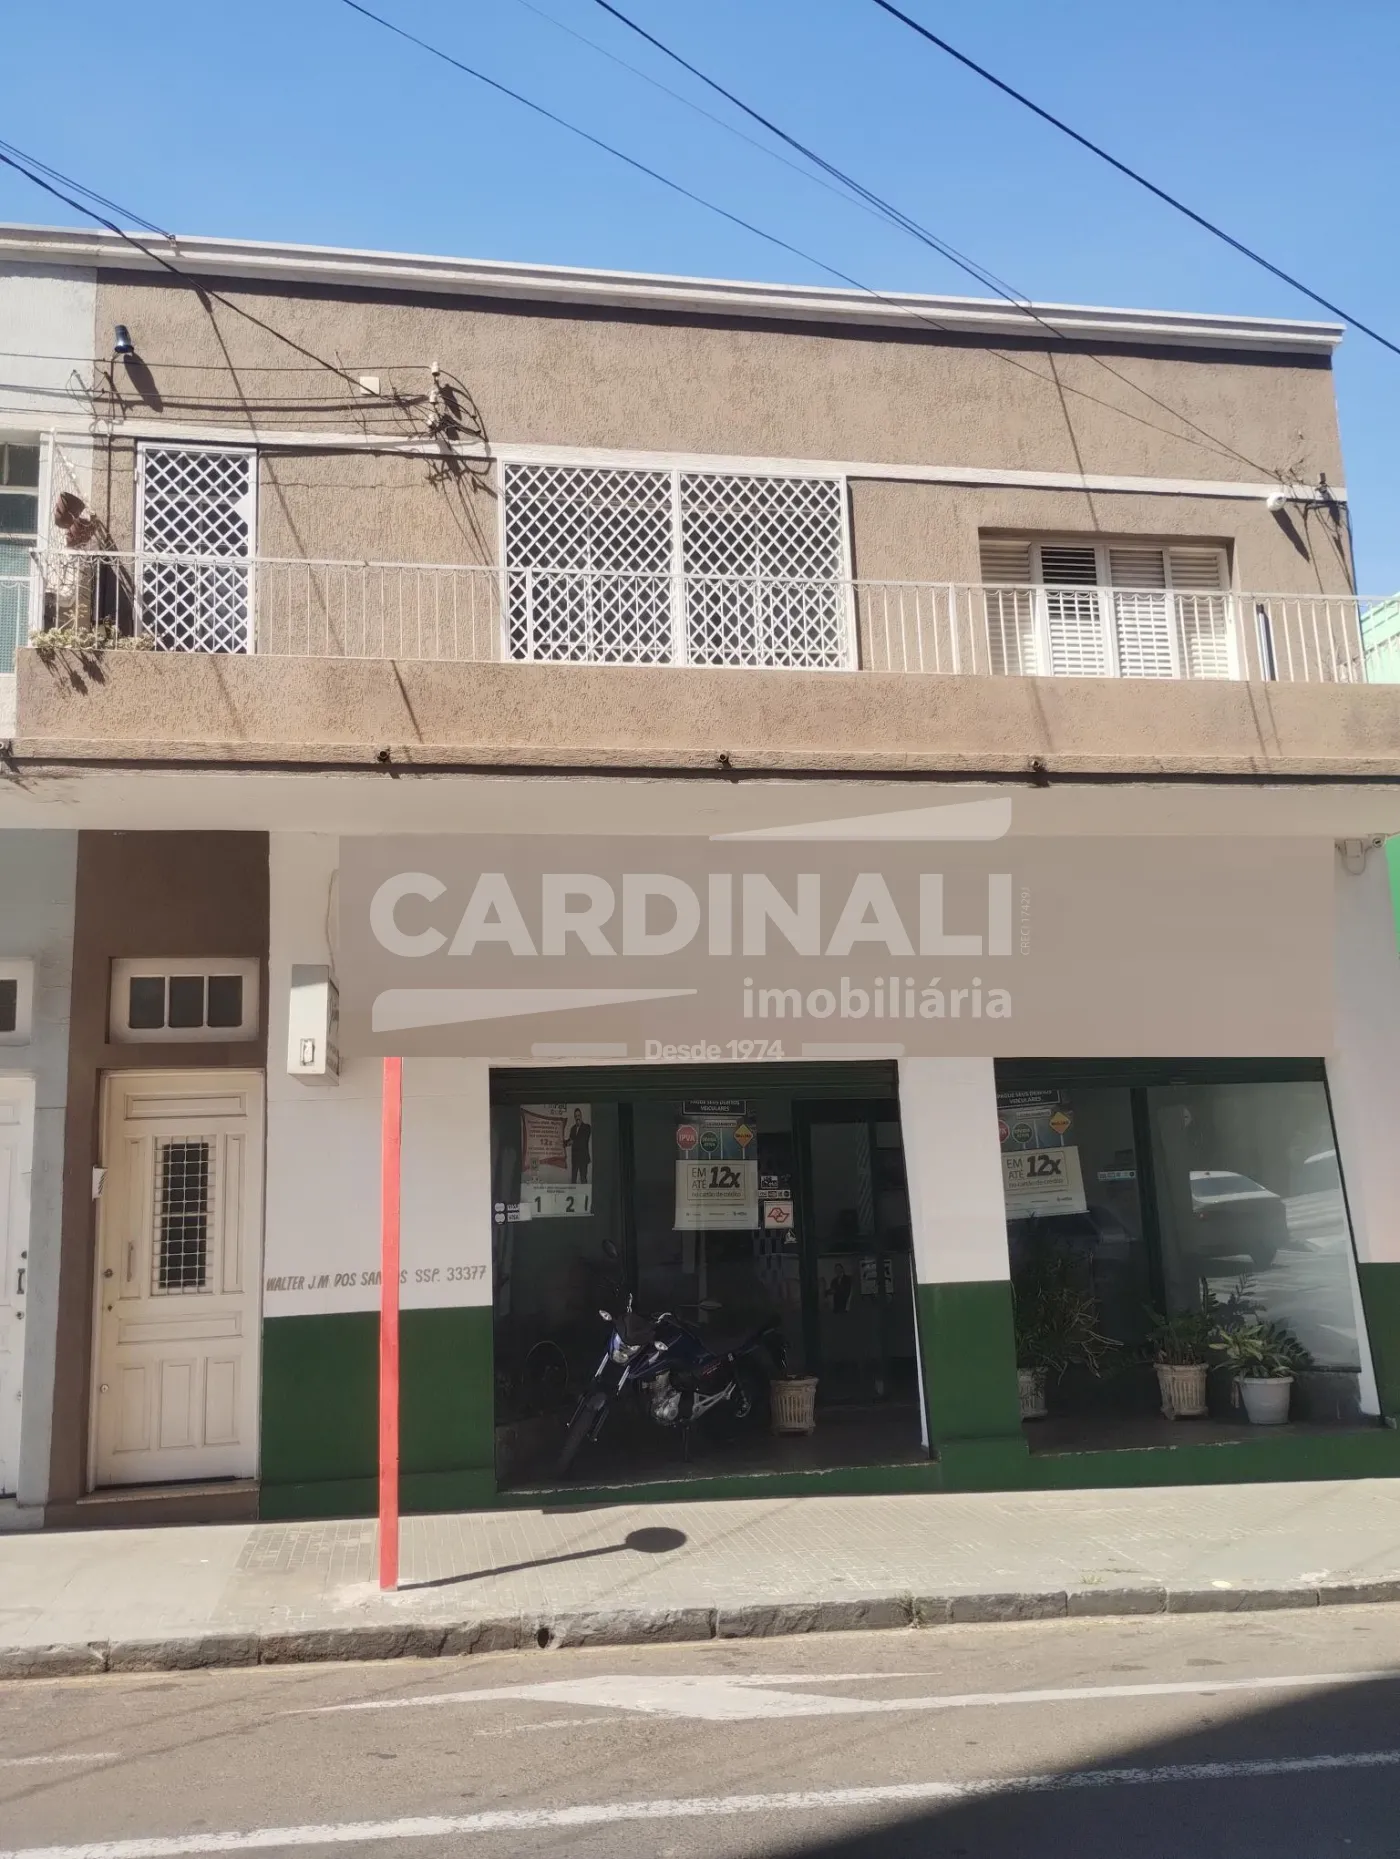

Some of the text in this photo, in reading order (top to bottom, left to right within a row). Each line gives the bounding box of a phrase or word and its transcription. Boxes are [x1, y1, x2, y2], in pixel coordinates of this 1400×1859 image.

[679, 1134, 696, 1142] IPVA
[1006, 1158, 1024, 1169] EM
[1026, 1154, 1062, 1177] 12x
[691, 1167, 707, 1178] EM
[708, 1166, 741, 1188] 12x
[1008, 1169, 1025, 1180] ATÉ
[691, 1178, 707, 1189] ATÉ
[565, 1196, 575, 1213] 2
[266, 1276, 304, 1292] WALTER
[334, 1272, 357, 1288] DOS
[360, 1269, 408, 1286] SANS
[446, 1265, 487, 1282] 33377
